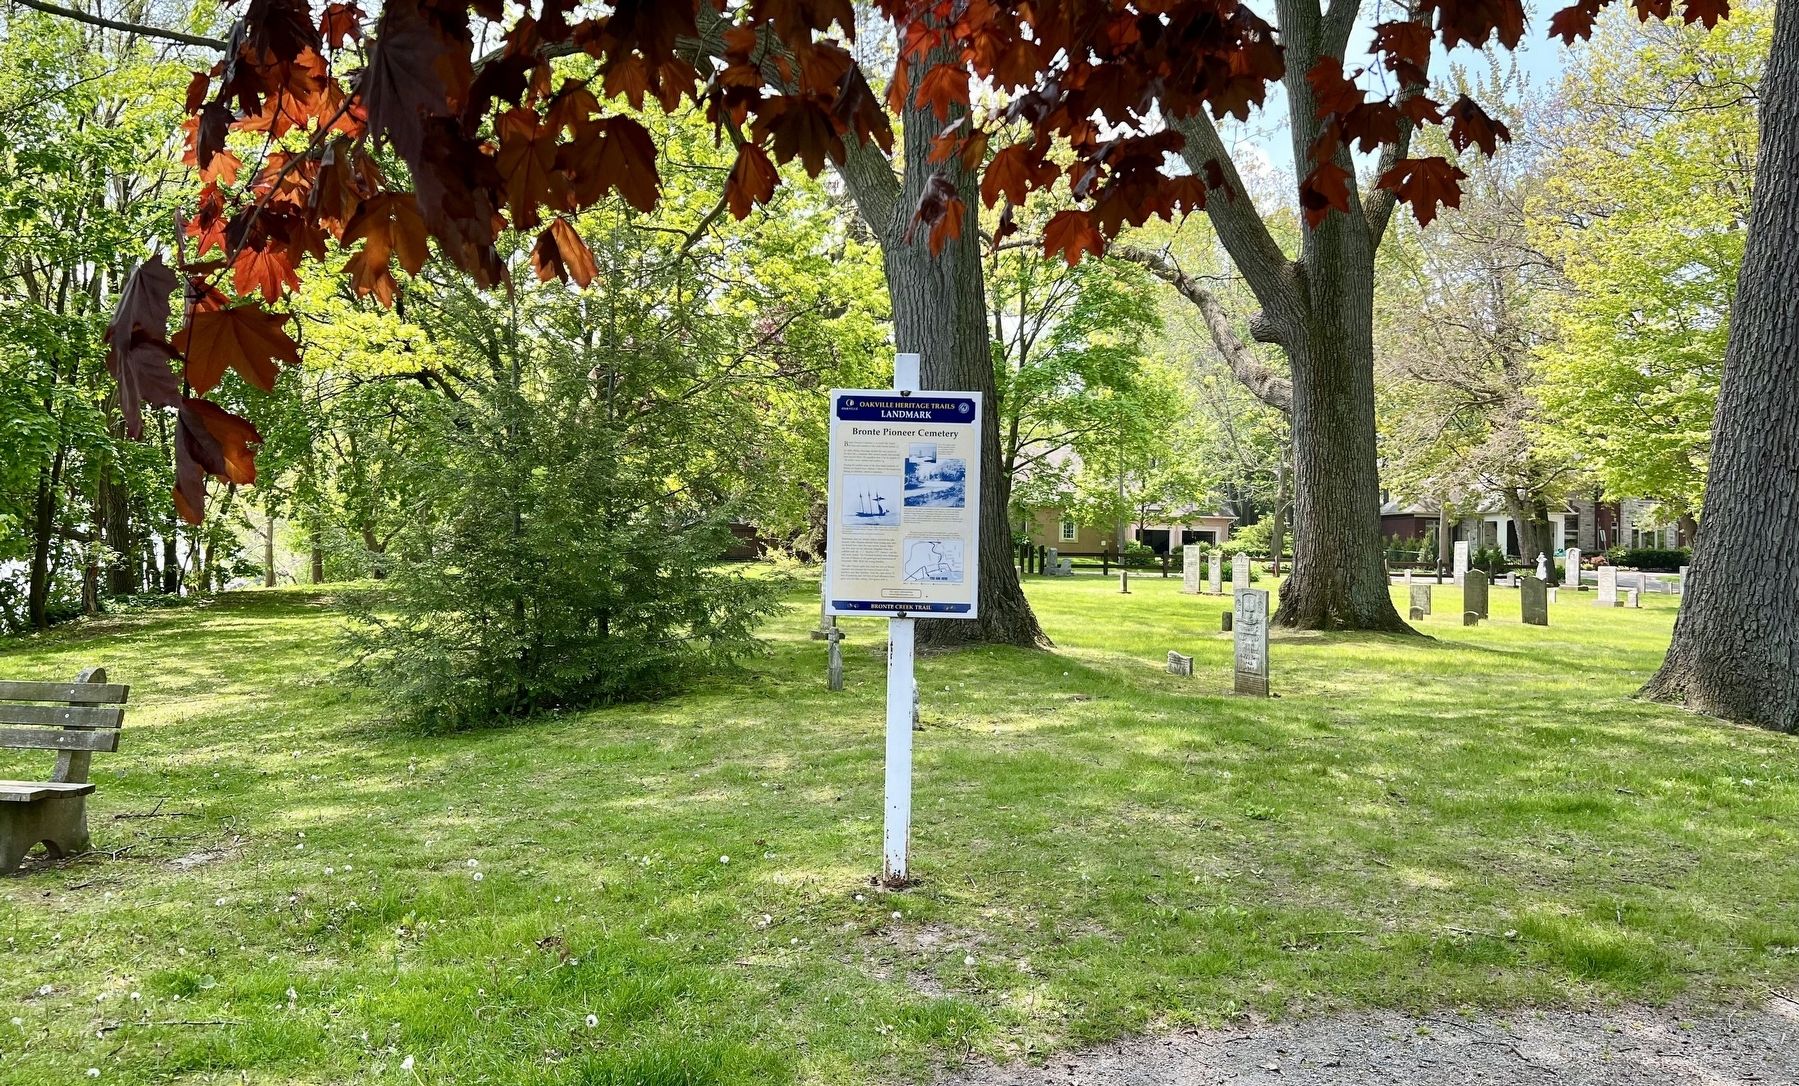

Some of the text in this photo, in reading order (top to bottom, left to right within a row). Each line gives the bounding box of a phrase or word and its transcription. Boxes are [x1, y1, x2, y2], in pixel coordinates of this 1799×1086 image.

[881, 410, 932, 419] LANDMARK
[852, 427, 959, 439] Bronte Pioneer Cemetery
